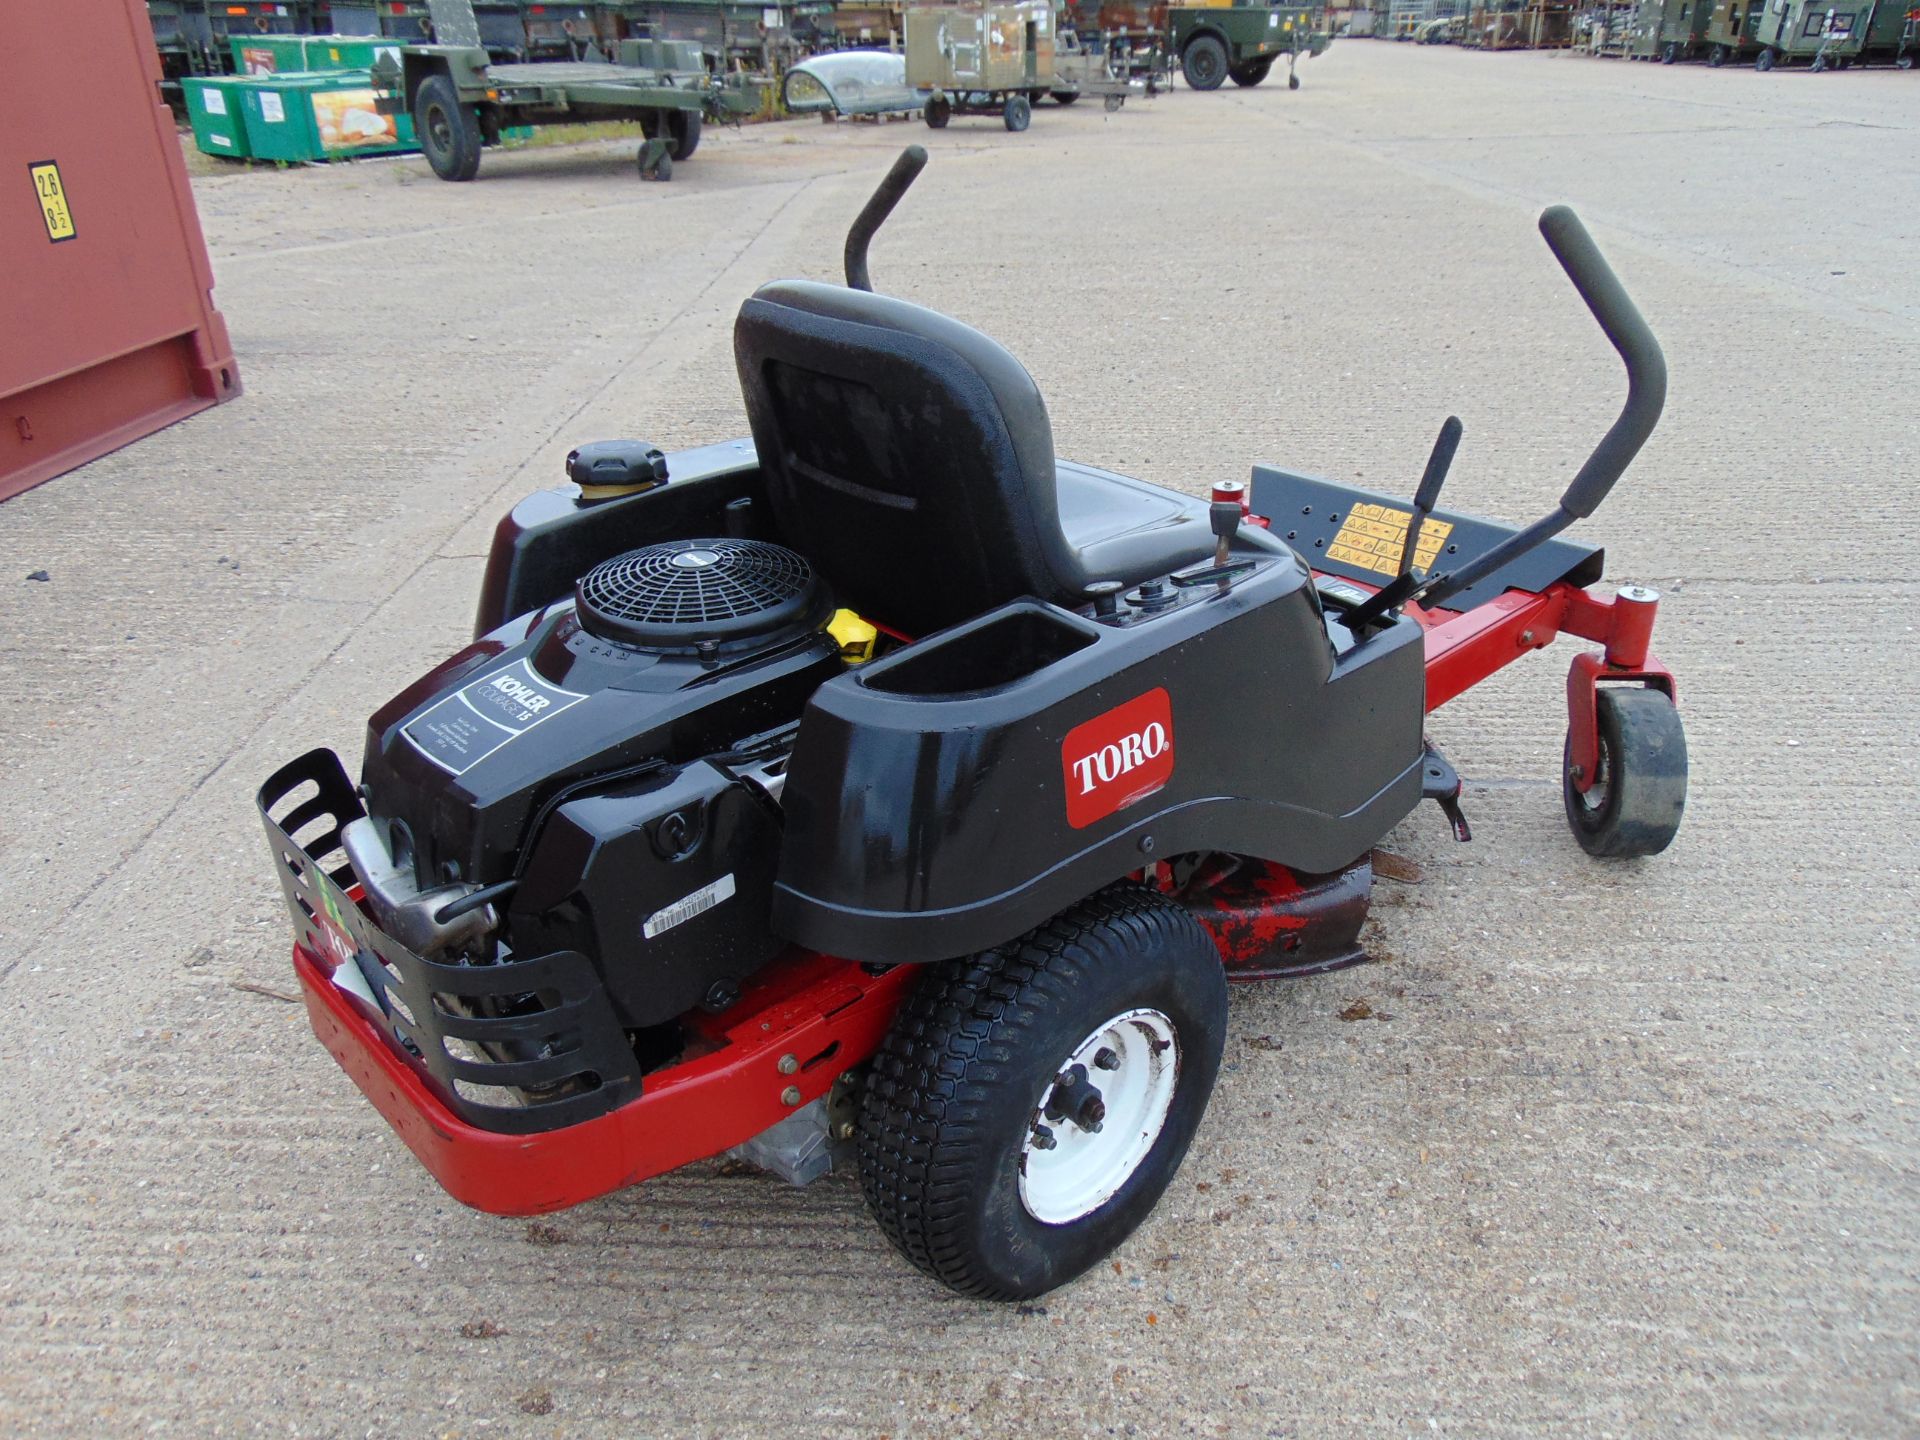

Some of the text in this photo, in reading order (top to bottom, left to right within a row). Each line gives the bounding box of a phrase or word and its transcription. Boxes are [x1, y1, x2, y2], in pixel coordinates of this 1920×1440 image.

[47, 208, 57, 230] 8
[478, 685, 532, 721] COURAGE 15
[490, 675, 550, 713] KOHLER
[1073, 722, 1165, 795] TORO
